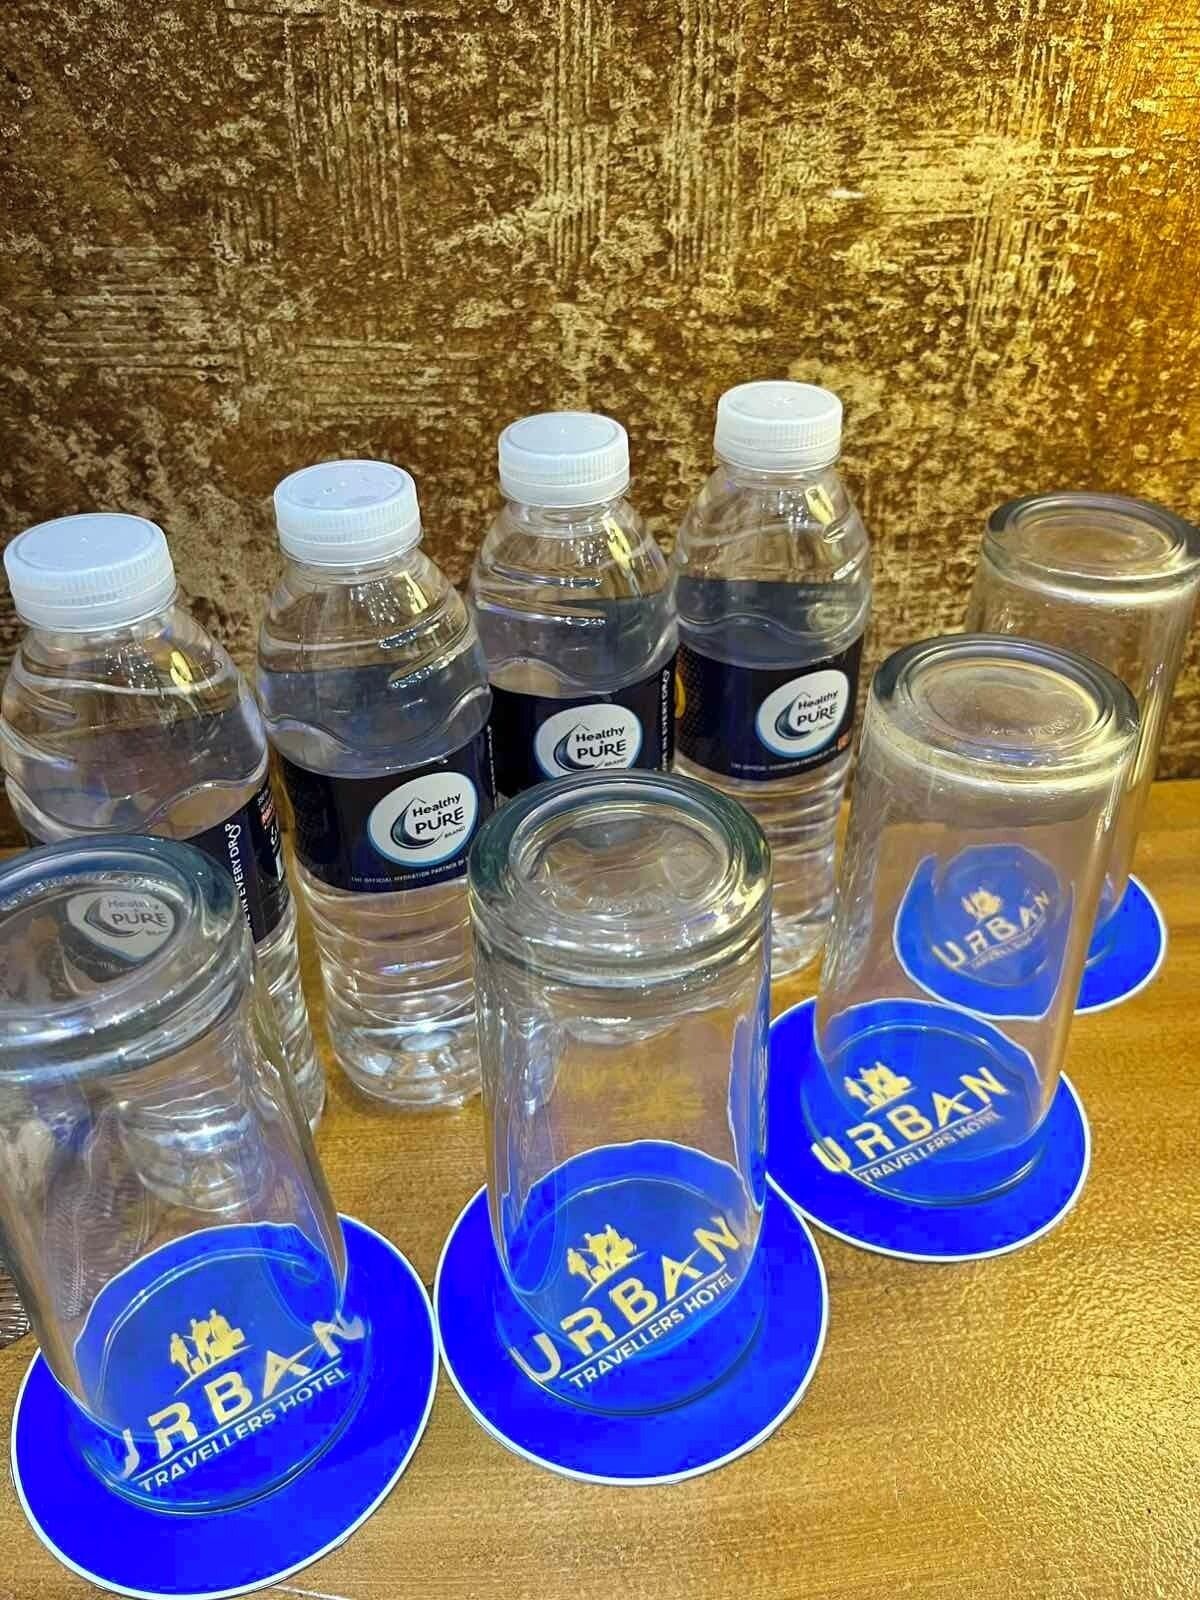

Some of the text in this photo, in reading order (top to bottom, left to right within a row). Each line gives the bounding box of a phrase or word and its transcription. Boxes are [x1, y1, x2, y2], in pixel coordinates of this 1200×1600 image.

[797, 702, 838, 727] PURE
[576, 726, 625, 743] Healthy
[577, 739, 627, 760] PURE
[412, 793, 462, 817] Healthy
[415, 807, 465, 835] PURE
[224, 823, 241, 858] DROP
[231, 858, 246, 897] EVERY
[111, 912, 168, 927] PURE
[811, 1066, 1009, 1174] URBAN
[858, 1130, 957, 1183] TRAVELLERS
[509, 1215, 741, 1383] URBAN
[568, 1272, 737, 1389] TRAVELLERS HOTEL
[137, 1366, 350, 1492] TRAVELLERS HOTEL
